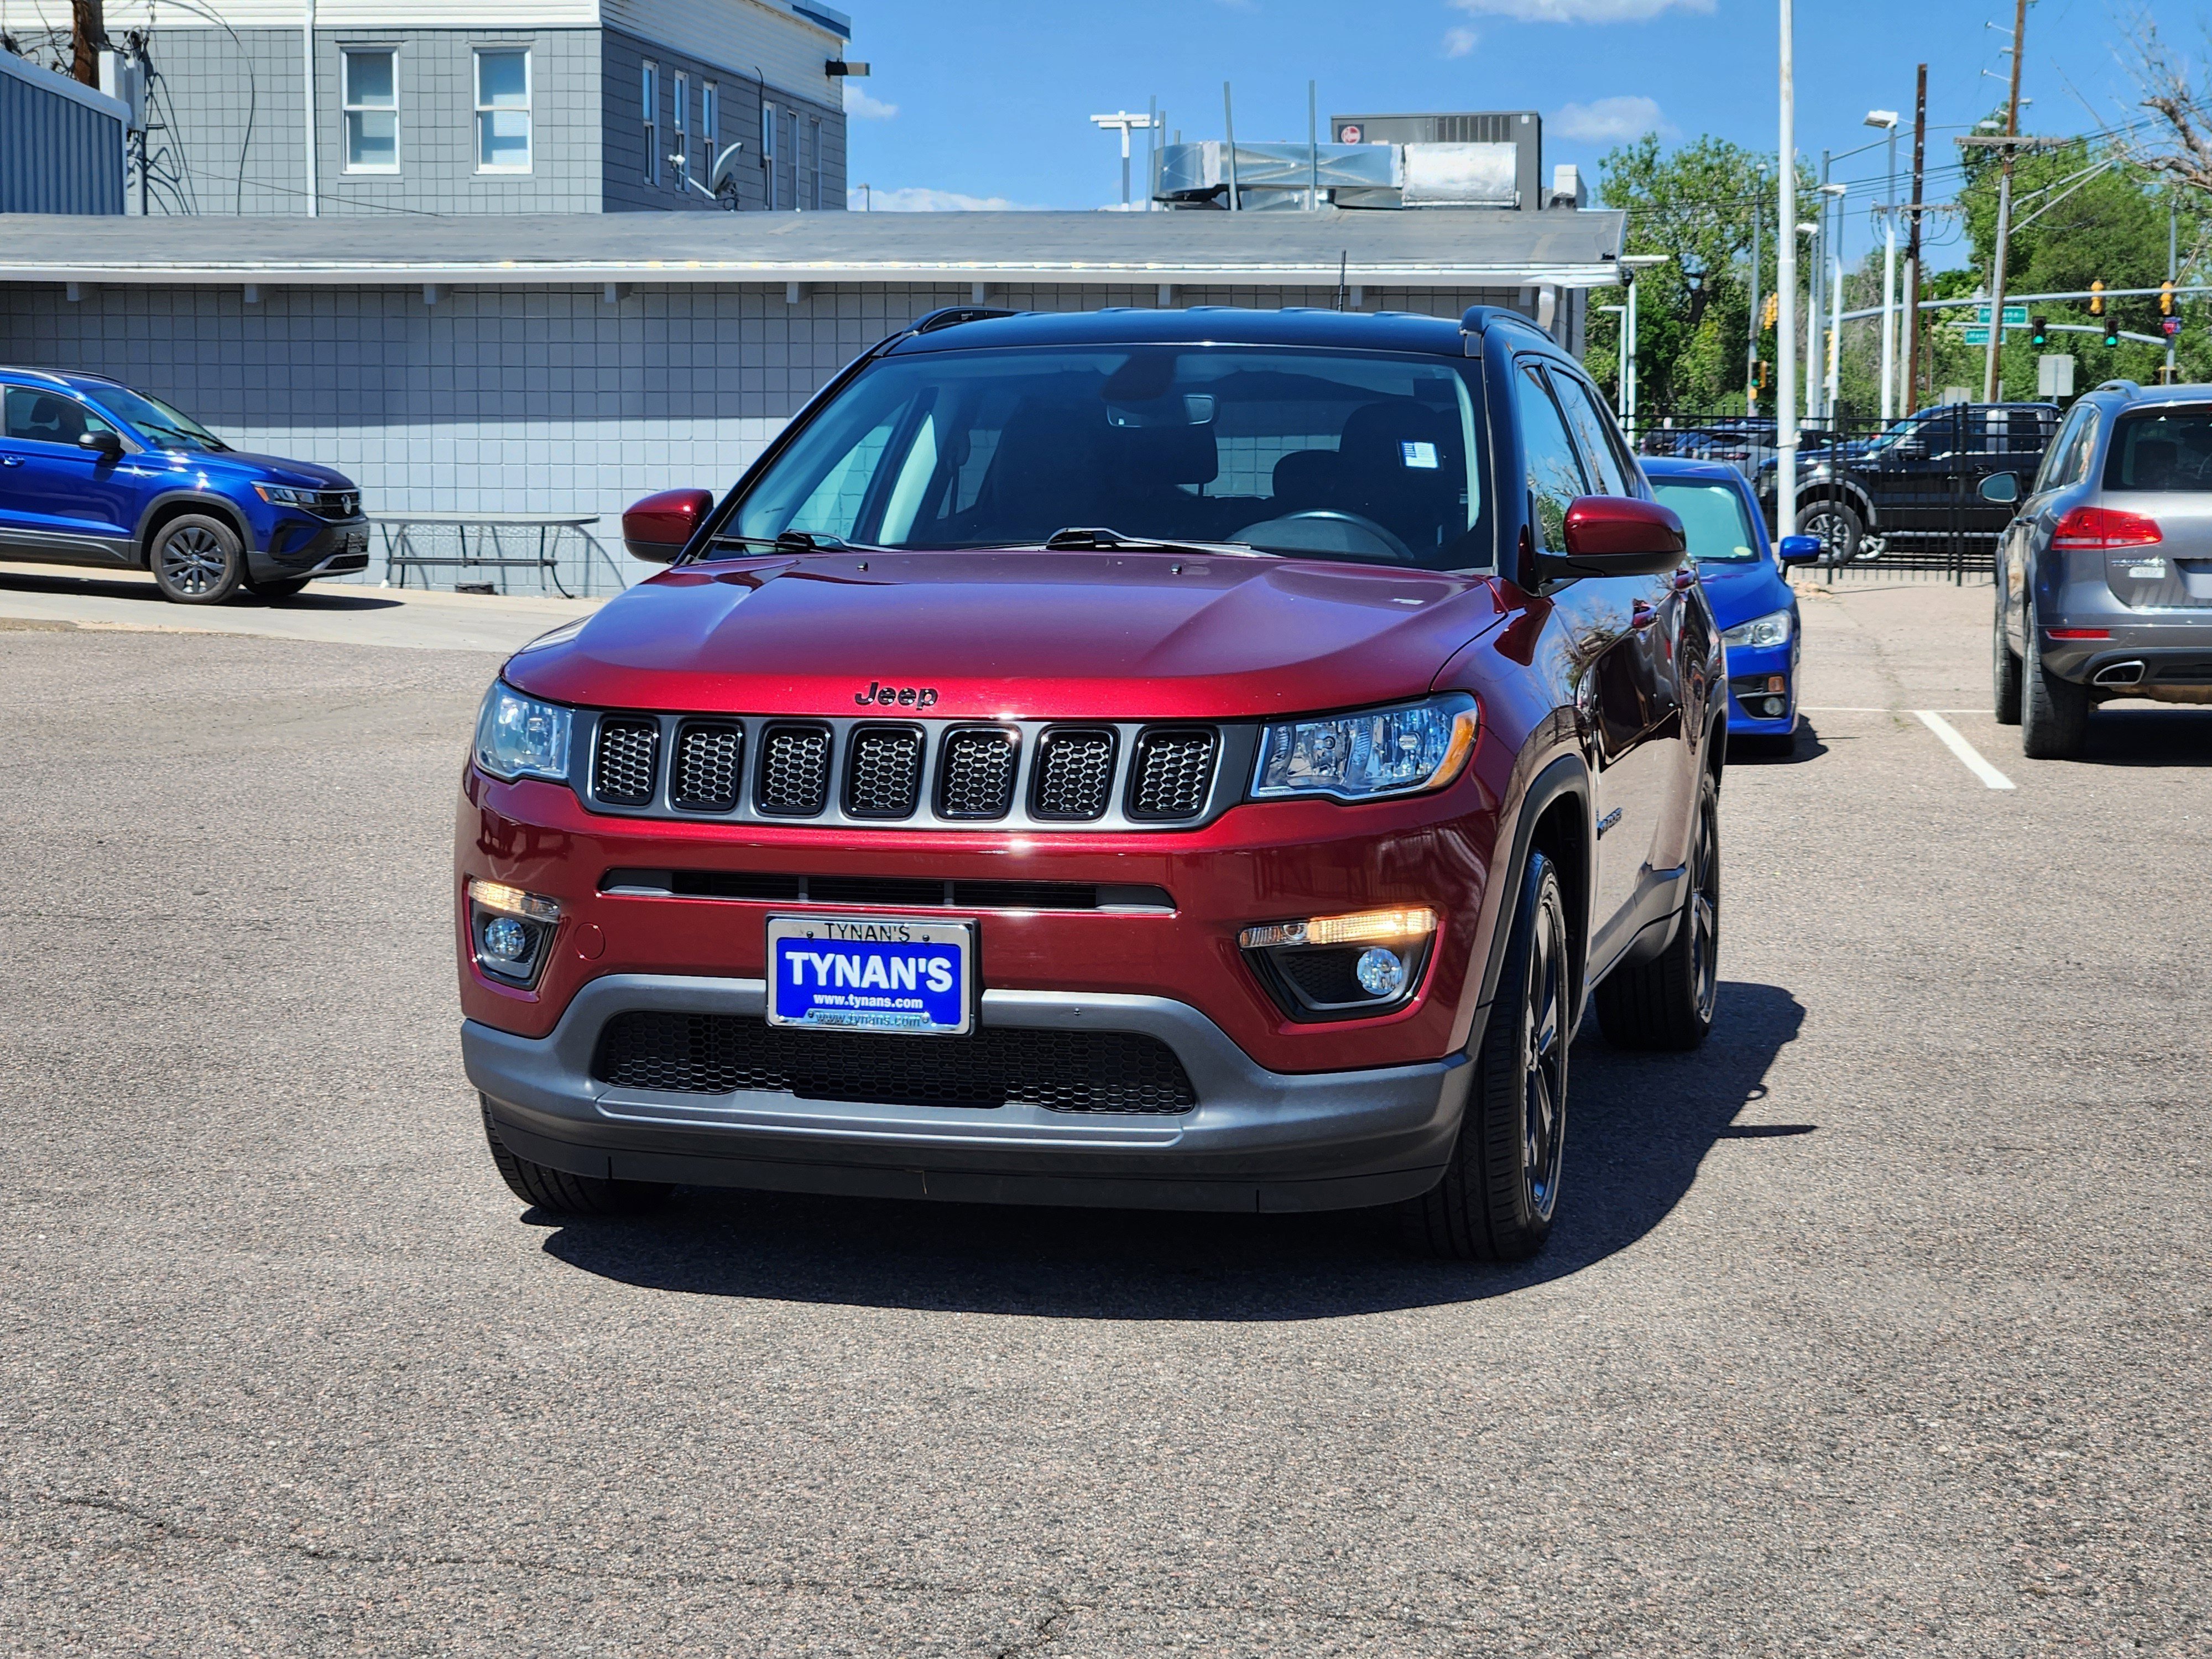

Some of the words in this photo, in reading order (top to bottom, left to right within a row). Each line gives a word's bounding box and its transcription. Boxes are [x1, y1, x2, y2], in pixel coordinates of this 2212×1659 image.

[854, 681, 939, 711] Jeep
[825, 923, 911, 942] TYNAN'S
[785, 951, 953, 993] TYNAN'S
[813, 993, 924, 1009] www.tynans.com
[816, 1010, 921, 1027] www.tynans.com
